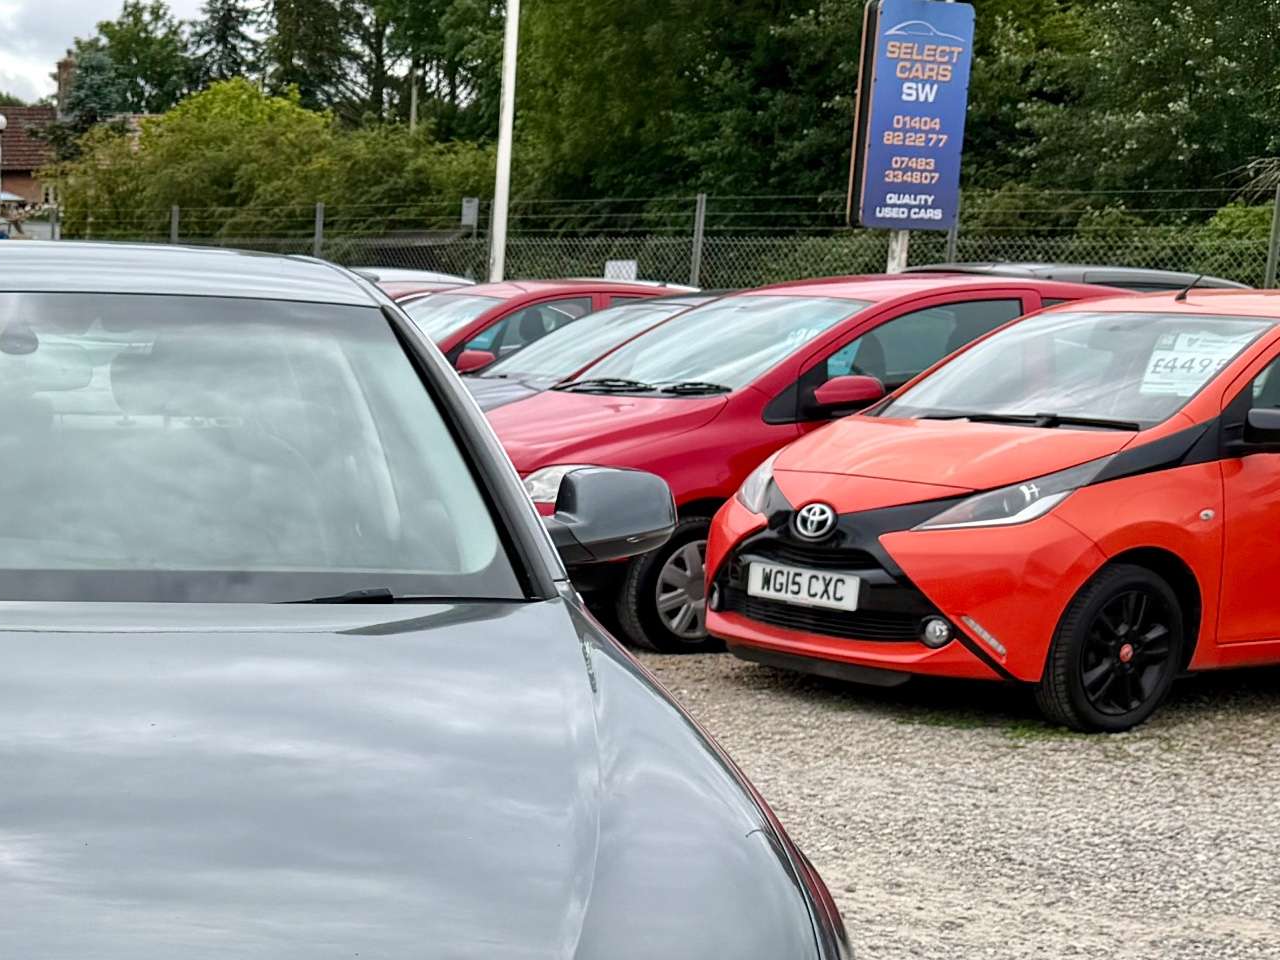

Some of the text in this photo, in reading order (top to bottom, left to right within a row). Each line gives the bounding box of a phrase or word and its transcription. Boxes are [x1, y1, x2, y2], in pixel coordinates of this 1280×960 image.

[886, 41, 963, 63] SELECT
[896, 61, 952, 81] CARS
[901, 82, 938, 102] SW
[893, 115, 940, 130] 01404
[891, 156, 935, 170] 07483
[884, 170, 940, 184] 334807
[886, 193, 935, 205] QUALITY
[876, 206, 942, 220] USED CARS
[761, 567, 846, 602] WG15 CXC
